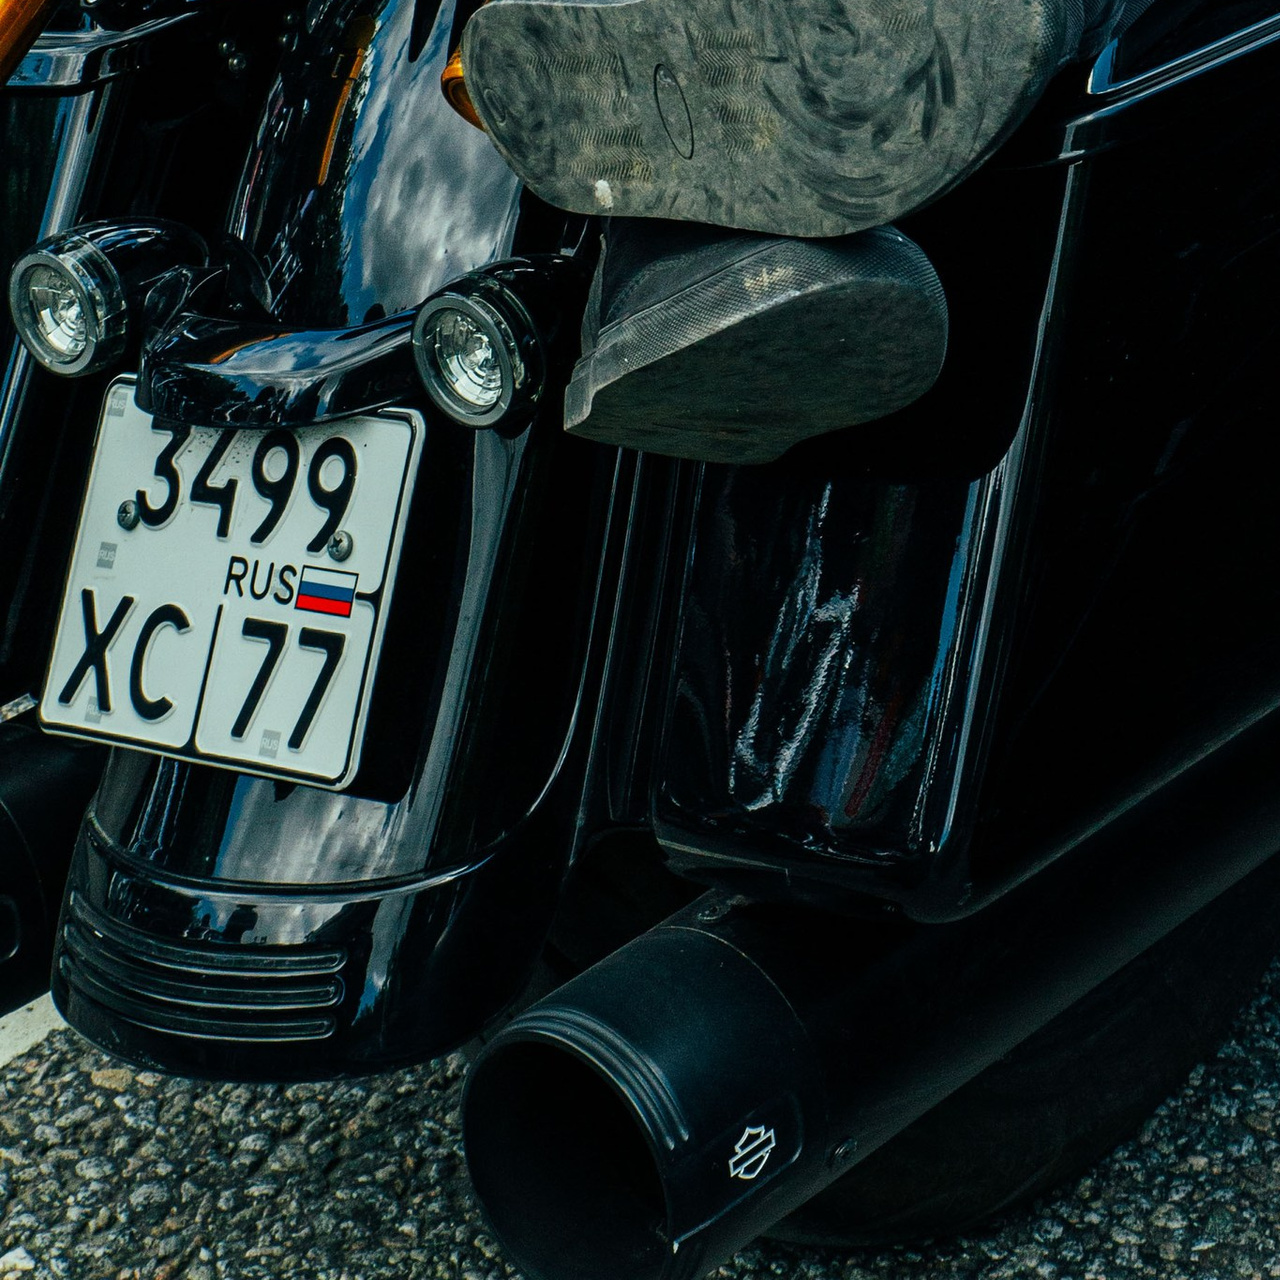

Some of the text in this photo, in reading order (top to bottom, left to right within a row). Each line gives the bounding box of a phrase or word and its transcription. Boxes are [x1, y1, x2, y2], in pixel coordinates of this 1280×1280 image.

[136, 418, 358, 554] 3499
[223, 555, 299, 605] RUS
[230, 616, 347, 751] 77
